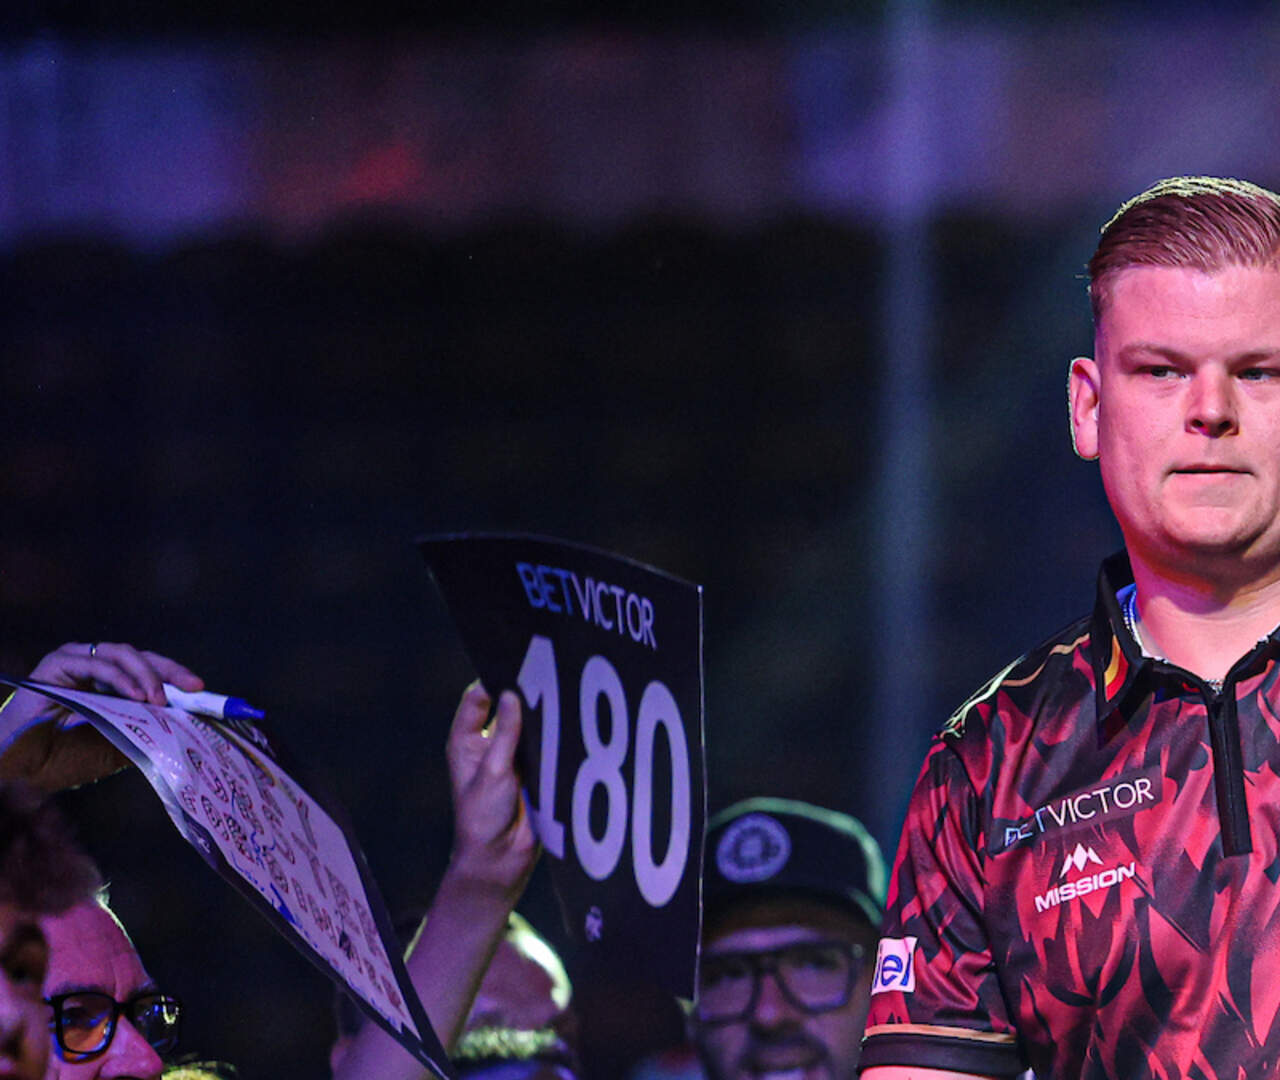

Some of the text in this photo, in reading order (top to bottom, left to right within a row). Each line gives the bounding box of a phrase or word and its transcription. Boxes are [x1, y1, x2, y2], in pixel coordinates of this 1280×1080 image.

[515, 561, 657, 649] BETVICTOR
[516, 634, 691, 907] 180
[1034, 861, 1137, 913] MISSION
